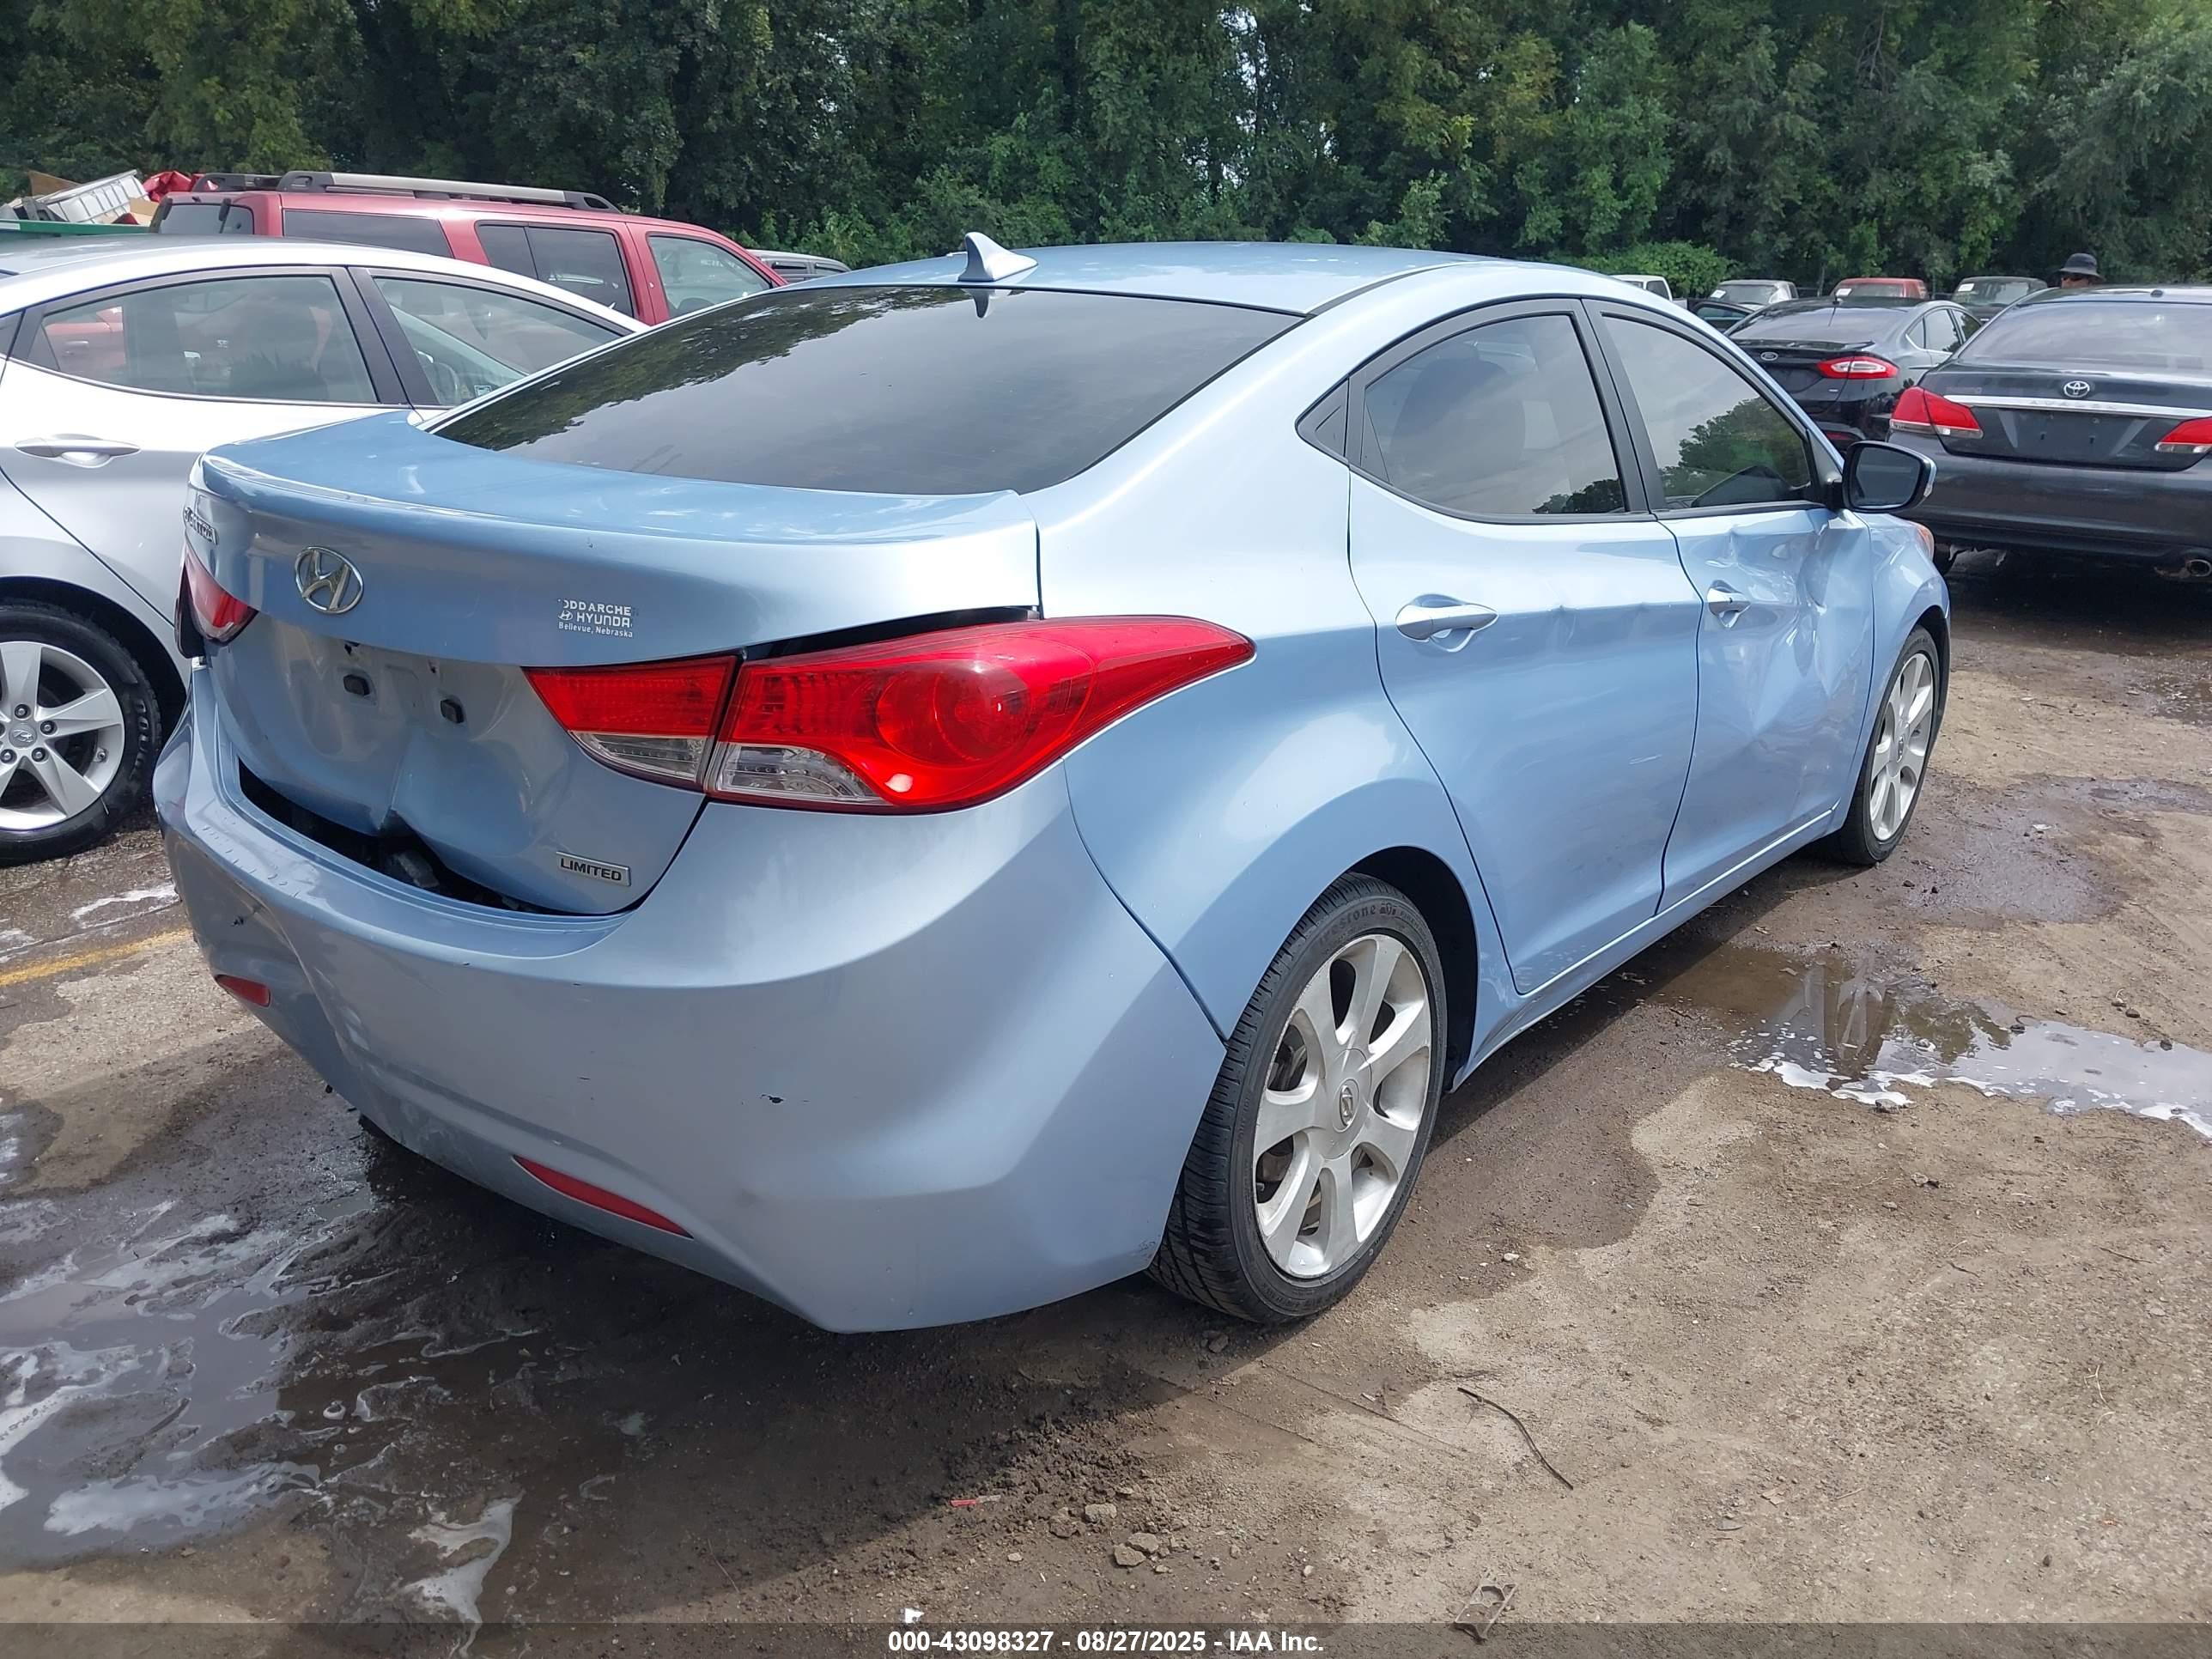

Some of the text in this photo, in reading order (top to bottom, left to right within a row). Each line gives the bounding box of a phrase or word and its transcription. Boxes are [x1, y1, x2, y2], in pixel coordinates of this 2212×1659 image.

[558, 621, 634, 638] Bellevue, Nebraska
[560, 858, 623, 881] LIMITED
